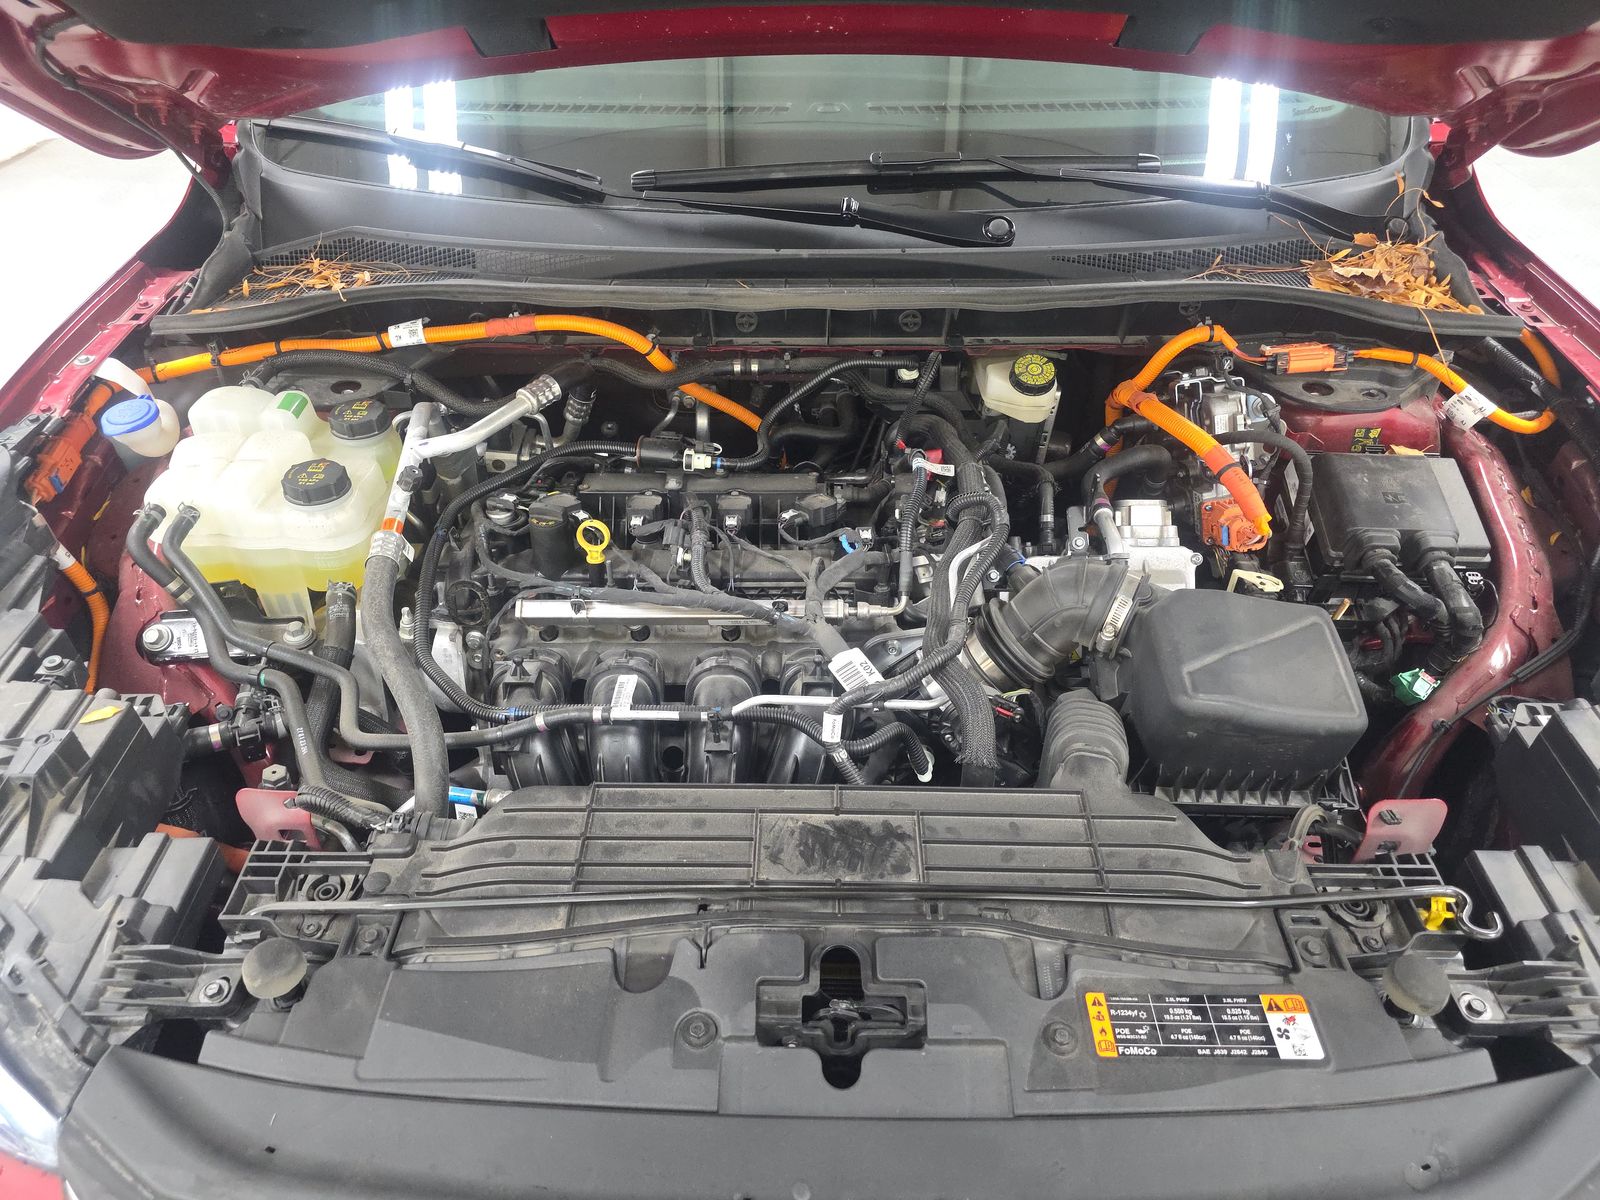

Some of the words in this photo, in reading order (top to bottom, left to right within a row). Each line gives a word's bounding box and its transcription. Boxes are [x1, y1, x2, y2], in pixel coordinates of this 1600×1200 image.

[860, 660, 875, 677] K02
[1242, 1008, 1250, 1016] kg
[1118, 1046, 1157, 1055] FoMoCo
